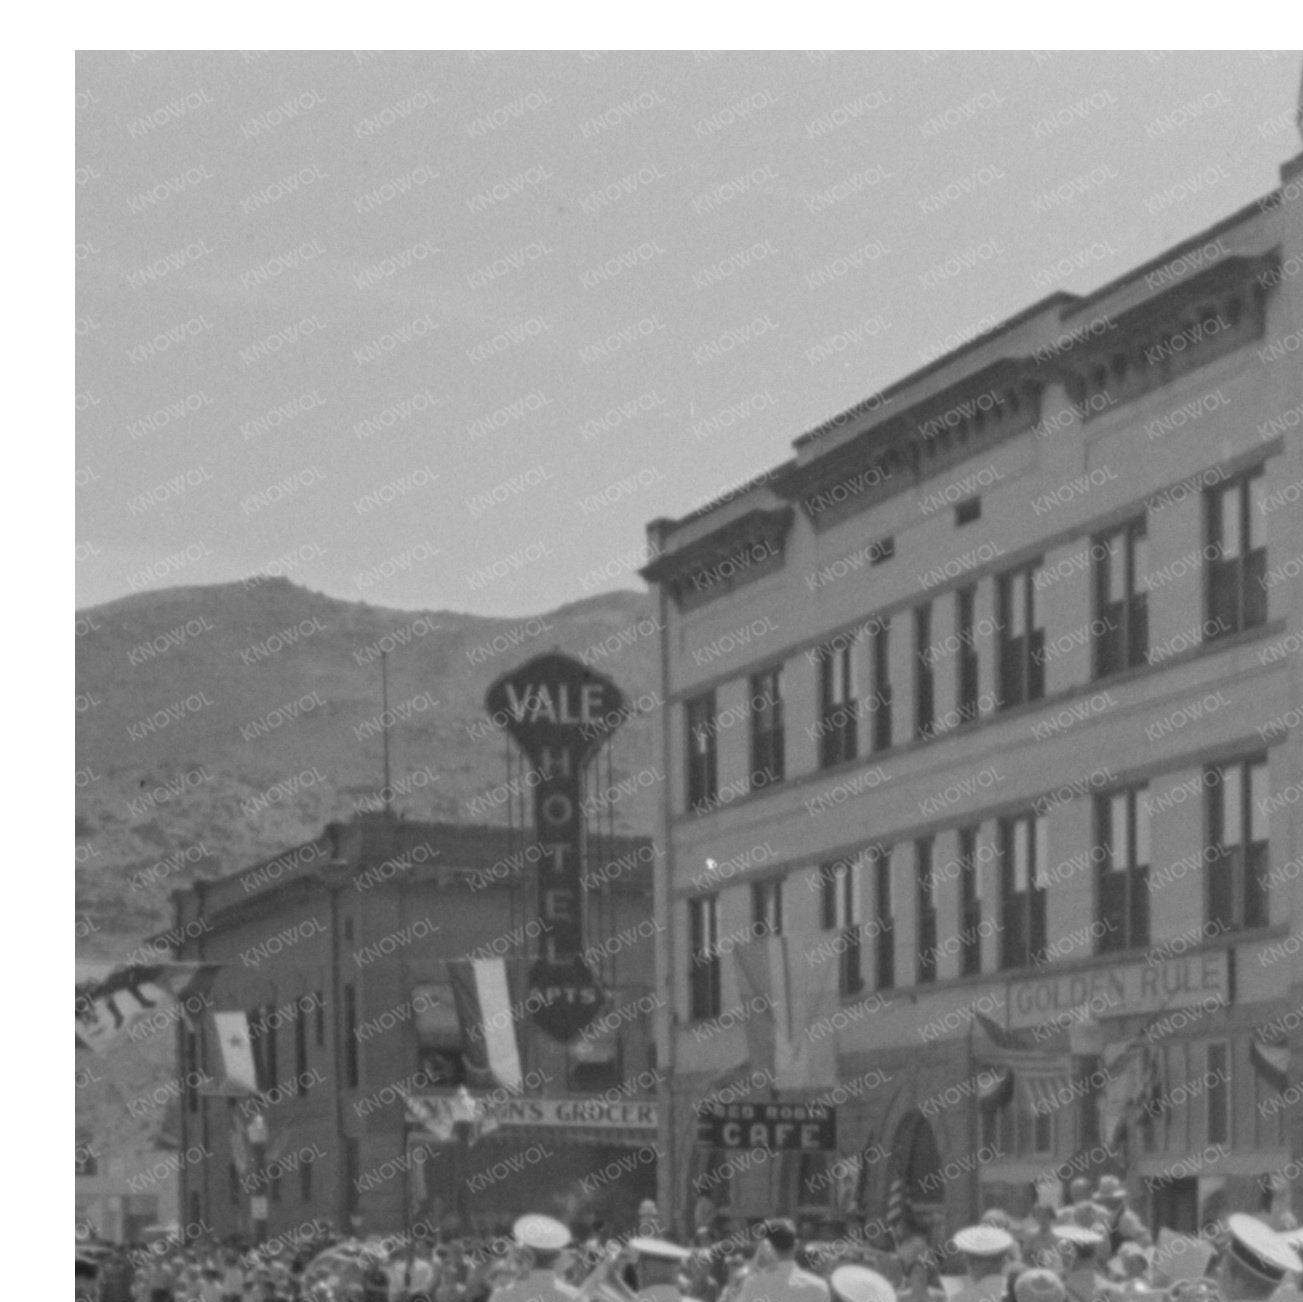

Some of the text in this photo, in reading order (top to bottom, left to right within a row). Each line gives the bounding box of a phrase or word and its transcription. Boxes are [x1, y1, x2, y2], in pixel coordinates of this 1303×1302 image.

[504, 682, 605, 727] VALE
[541, 746, 574, 967] HOTEL
[529, 986, 597, 1005] APTS
[1016, 954, 1221, 1013] GOLDEN RULE
[721, 1122, 822, 1149] CAFE
